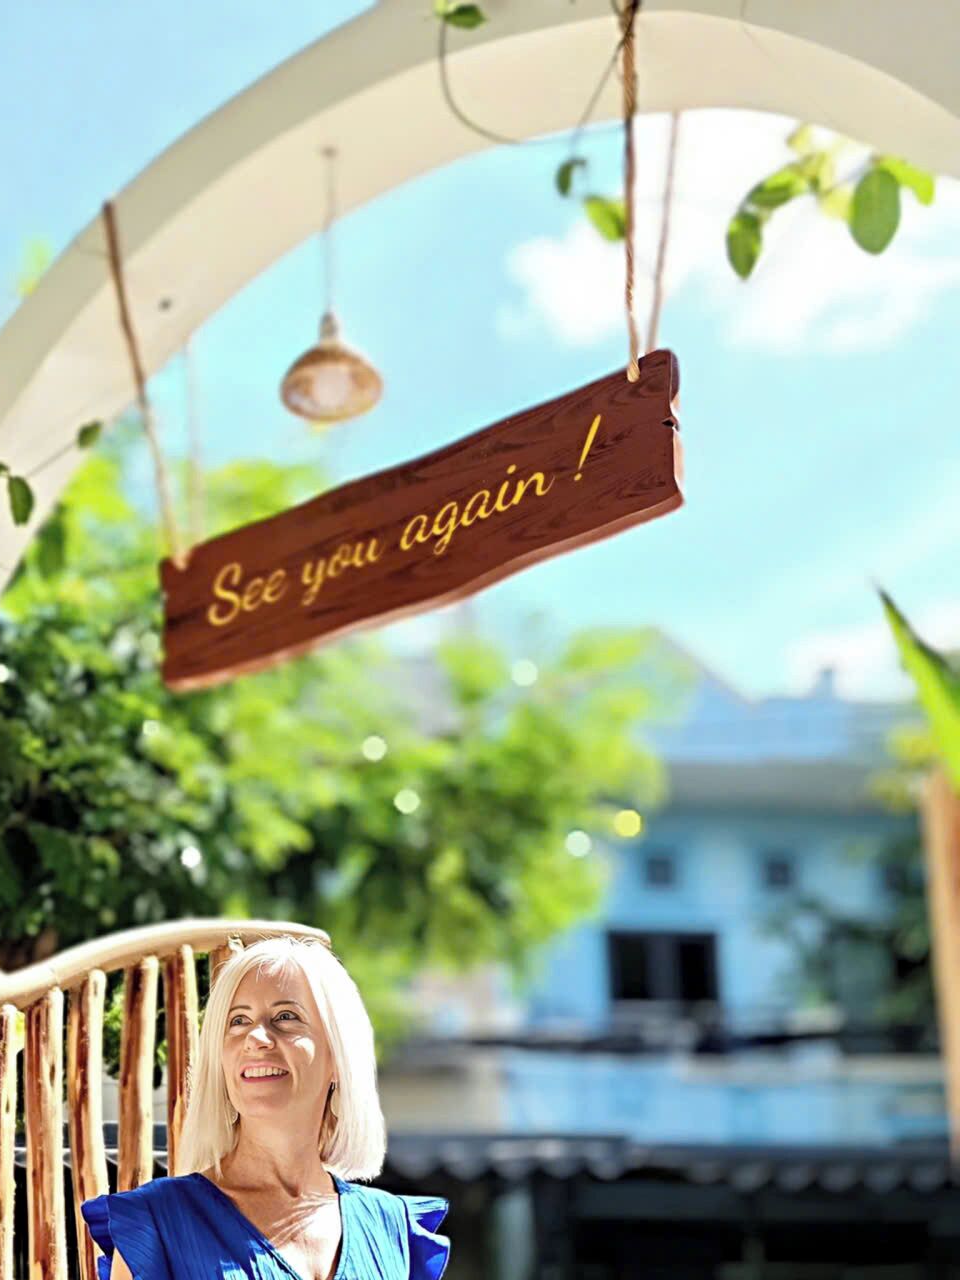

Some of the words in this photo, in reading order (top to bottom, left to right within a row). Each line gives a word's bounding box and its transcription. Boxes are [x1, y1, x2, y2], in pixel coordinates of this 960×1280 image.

[207, 562, 287, 627] See
[301, 537, 382, 606] you
[399, 463, 553, 556] again
